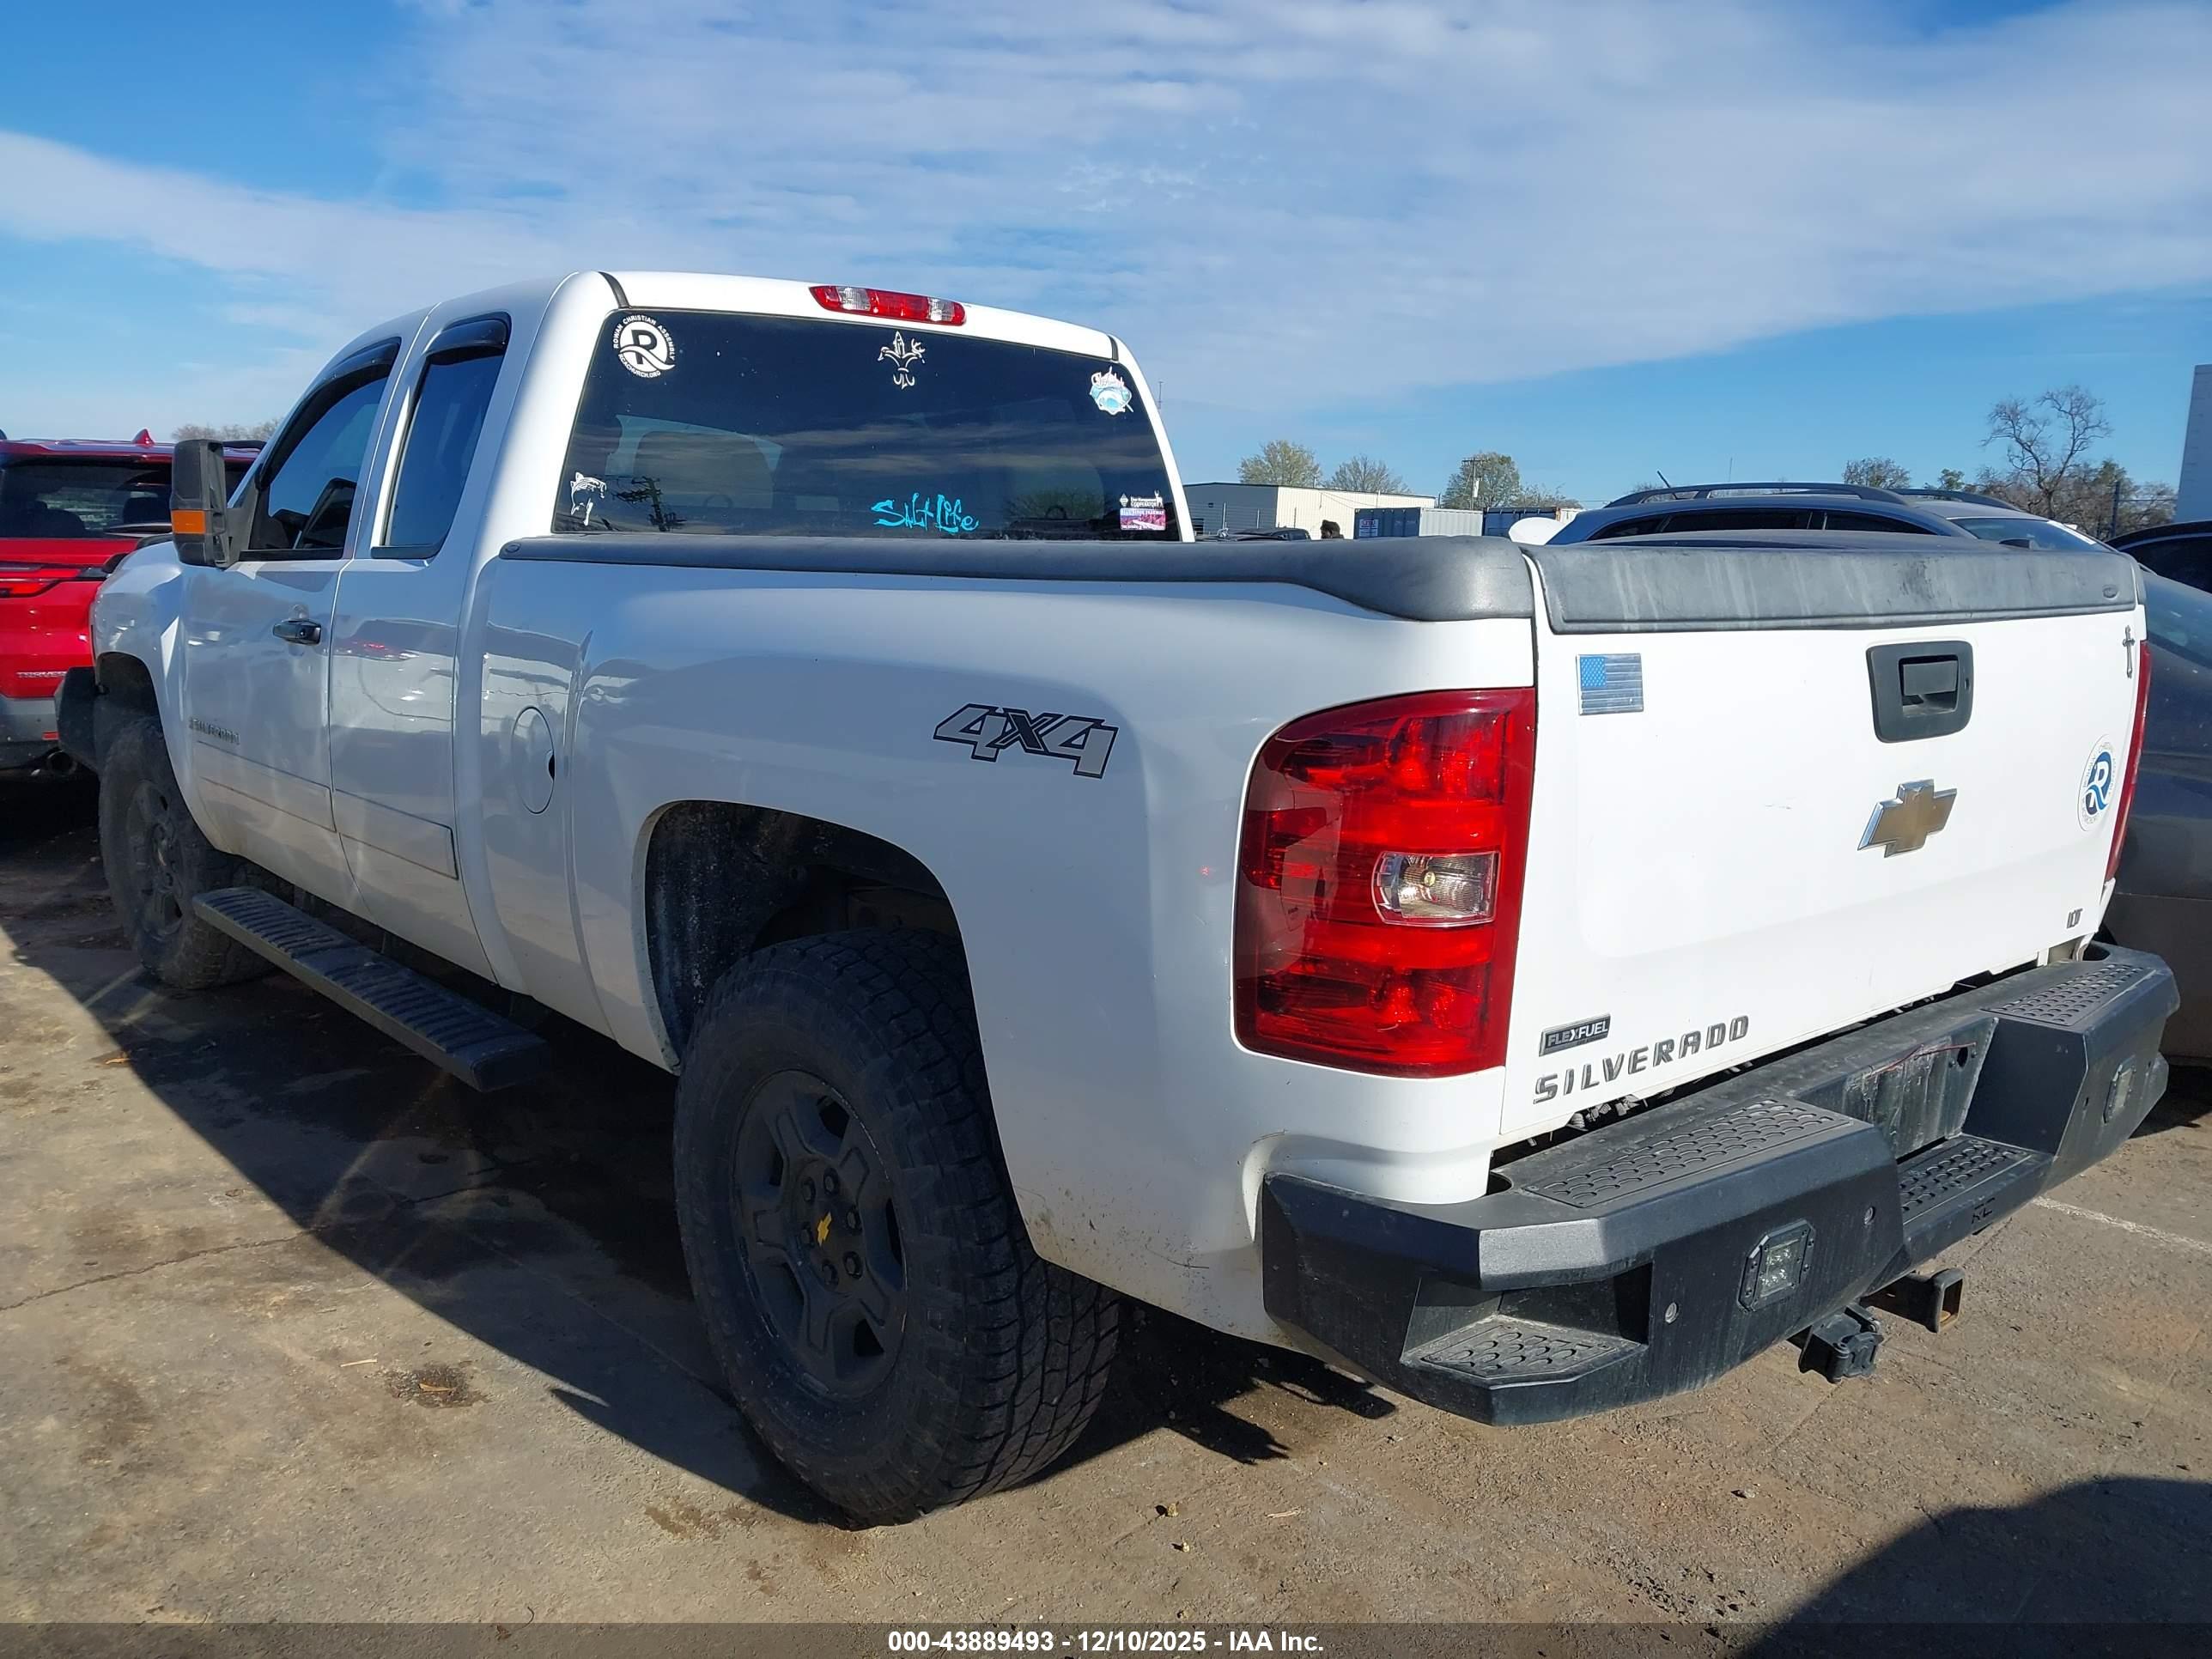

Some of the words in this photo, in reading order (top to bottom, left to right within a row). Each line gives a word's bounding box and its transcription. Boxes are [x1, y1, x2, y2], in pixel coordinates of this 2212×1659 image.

[612, 323, 623, 349] ROWAN
[623, 314, 657, 325] CHRISTIAN
[658, 325, 676, 361] ASSEMBLY
[618, 353, 661, 379] RCACHURCH.ORG
[2066, 908, 2083, 929] LT
[1547, 1019, 1609, 1048] FLEXFUEL
[1532, 1014, 1750, 1105] SILVERADO
